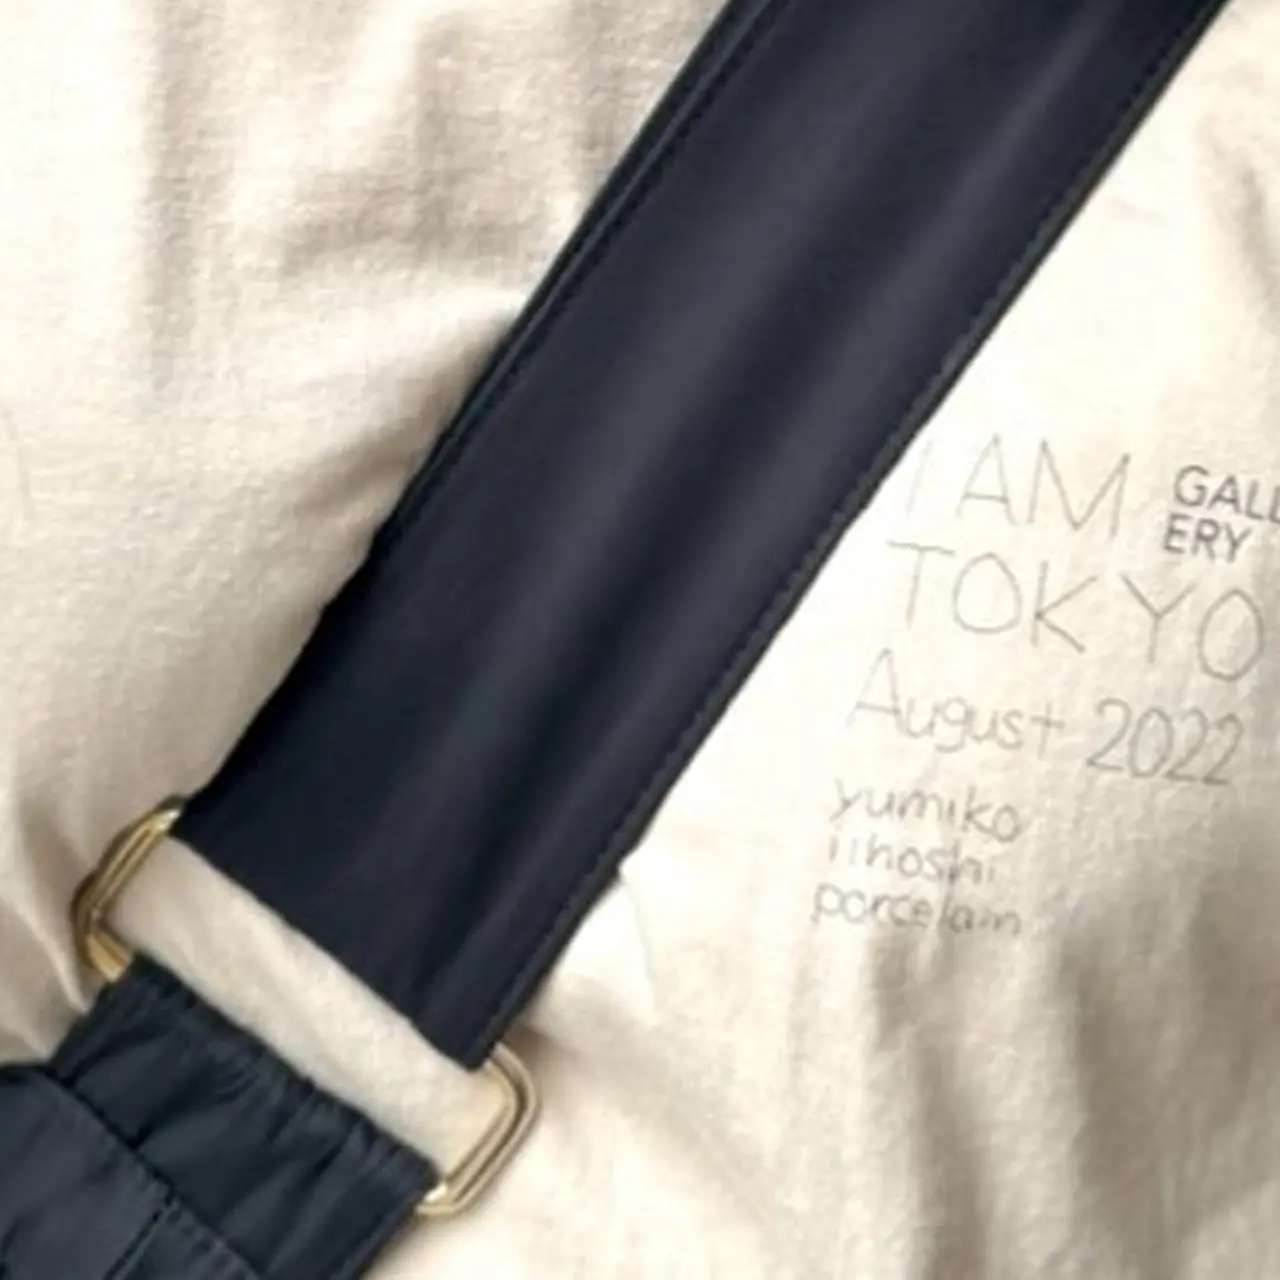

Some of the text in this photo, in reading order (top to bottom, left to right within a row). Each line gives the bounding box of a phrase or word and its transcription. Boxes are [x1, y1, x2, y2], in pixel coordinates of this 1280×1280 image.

[1163, 511, 1253, 564] ERY
[887, 541, 1264, 682] TOKYO
[844, 646, 1244, 786] August 2022
[829, 778, 1022, 844] yumiko
[810, 882, 1022, 939] porcelain
